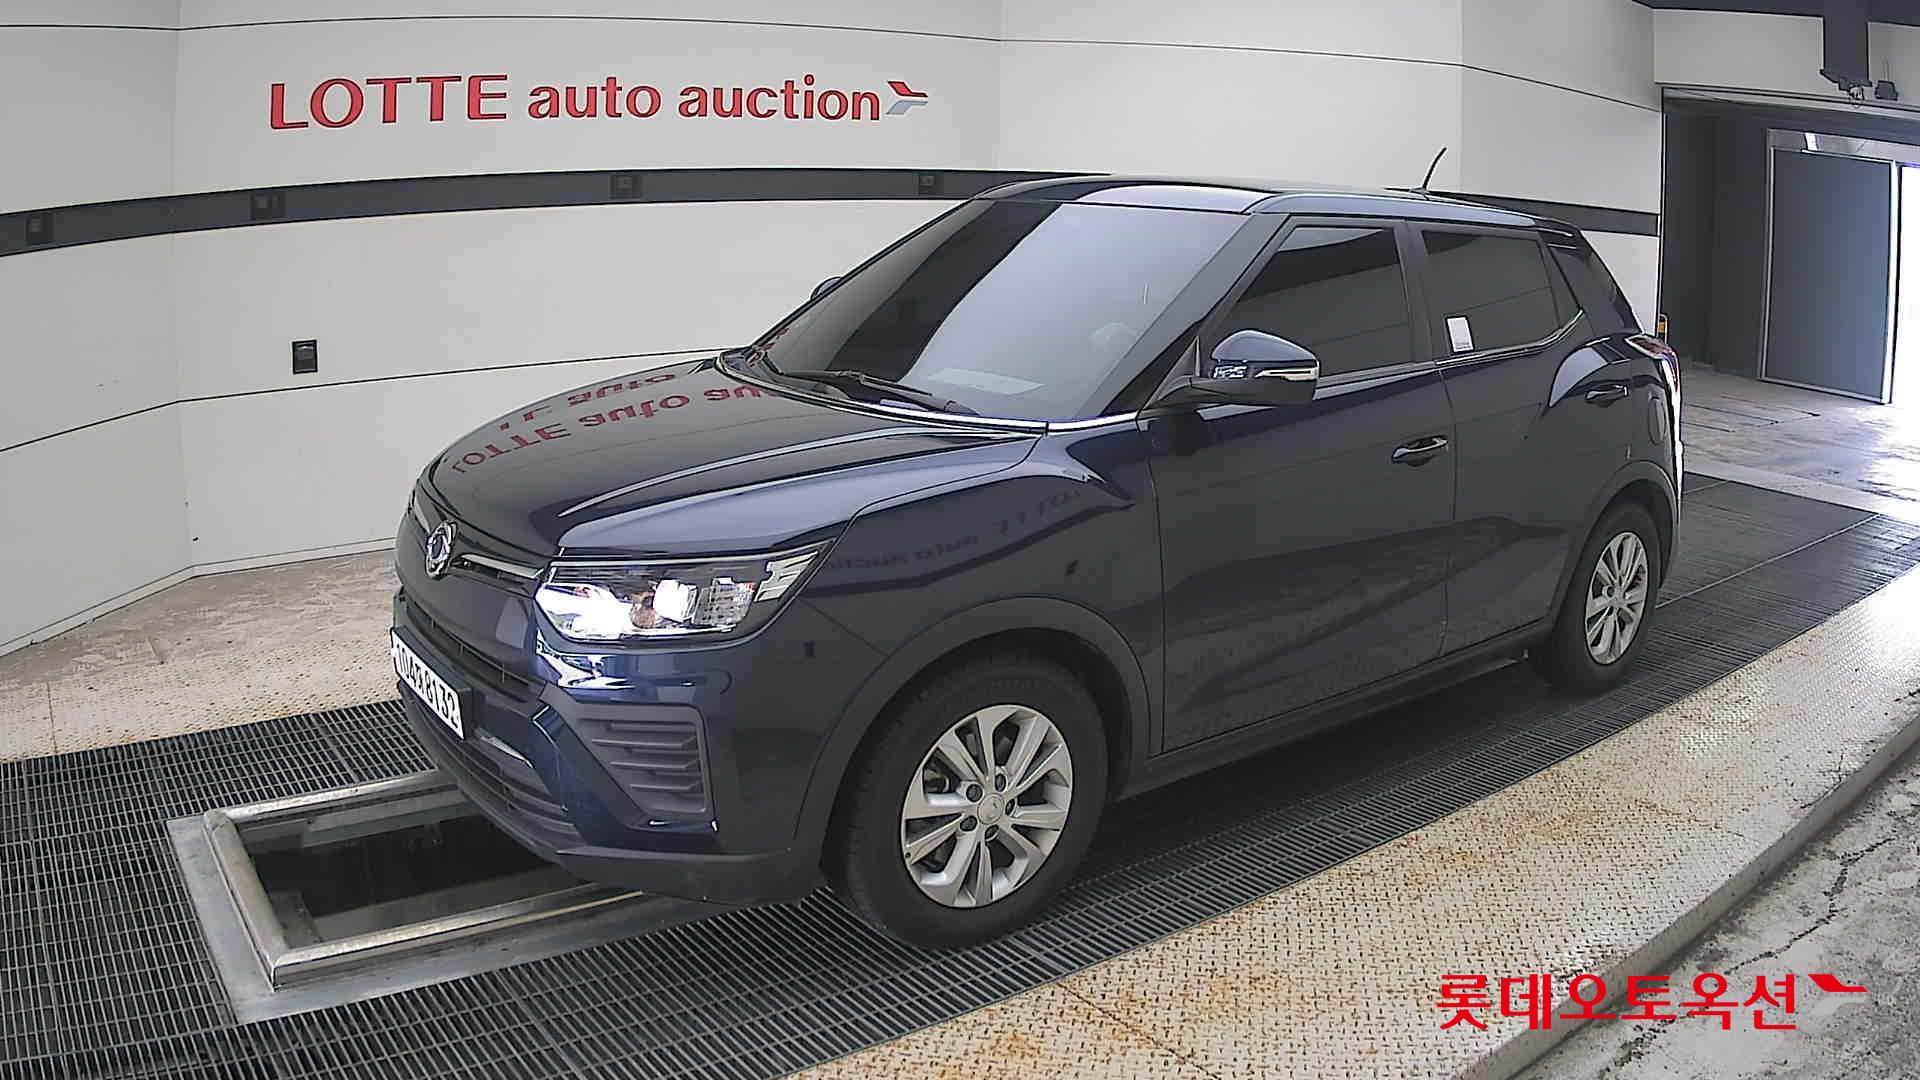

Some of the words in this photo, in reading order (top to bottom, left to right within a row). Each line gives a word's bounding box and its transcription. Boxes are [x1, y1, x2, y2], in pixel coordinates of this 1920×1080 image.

[270, 74, 507, 130] LOTTE
[527, 77, 662, 119] auto
[678, 74, 881, 120] auction
